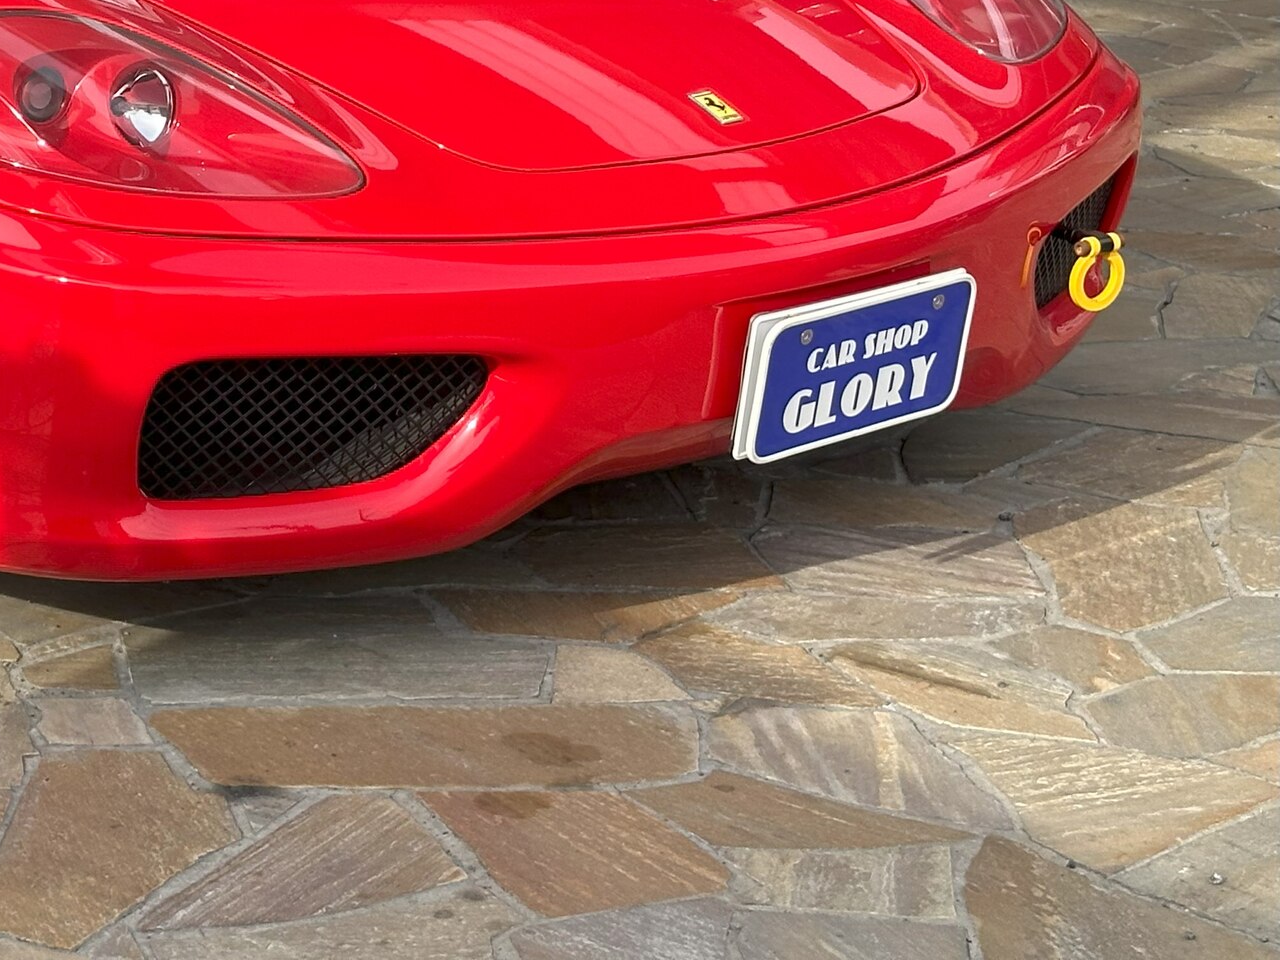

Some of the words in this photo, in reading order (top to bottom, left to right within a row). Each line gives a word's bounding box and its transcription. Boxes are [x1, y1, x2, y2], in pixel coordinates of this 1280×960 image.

[806, 339, 857, 373] CAR
[863, 319, 929, 359] SHOP
[782, 352, 938, 434] GLORY
